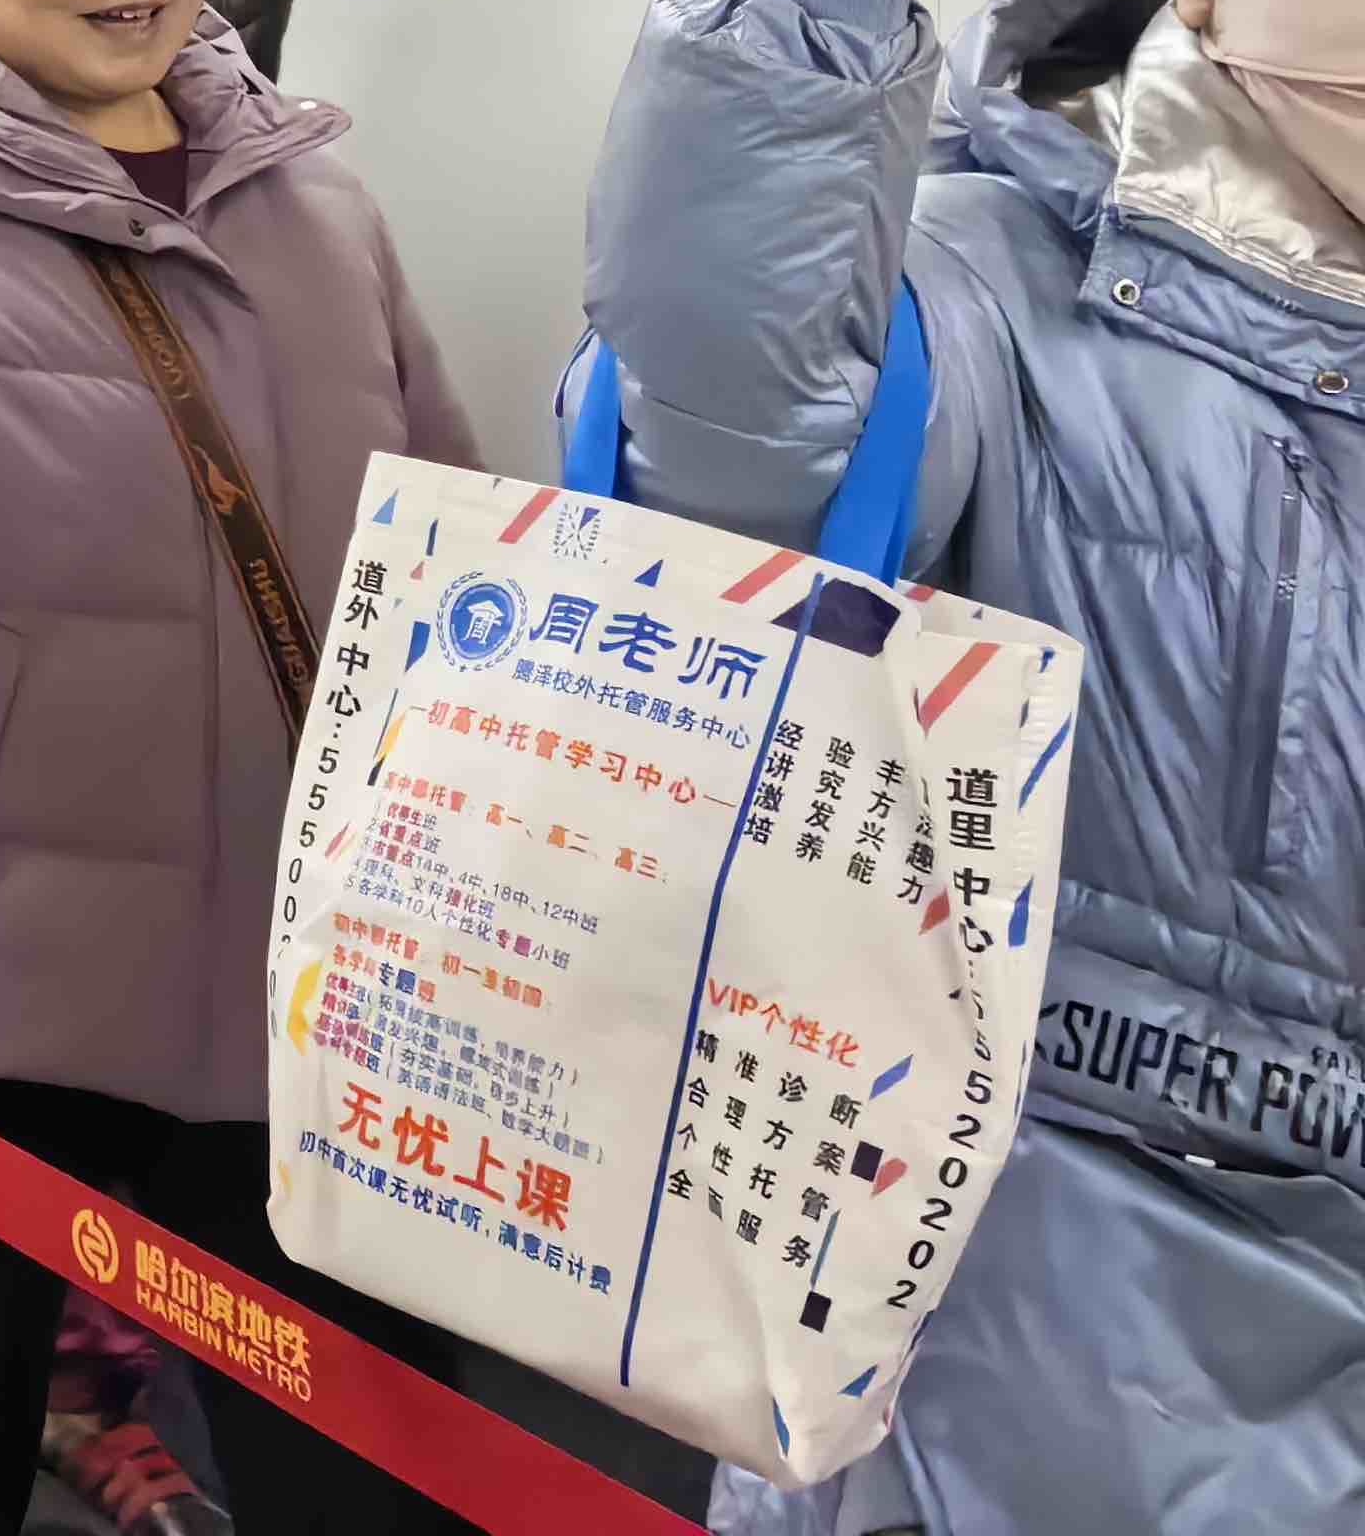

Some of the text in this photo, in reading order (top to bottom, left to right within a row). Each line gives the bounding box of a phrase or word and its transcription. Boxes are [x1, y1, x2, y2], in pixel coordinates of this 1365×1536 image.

[531, 592, 768, 701] 周老师
[773, 719, 931, 807] 经验丰
[743, 813, 926, 906] 培养能力
[753, 781, 935, 875] 激发兴趣
[708, 977, 859, 1069] VIP个性化
[1053, 1000, 1239, 1122] SUPER
[687, 1076, 846, 1176] 合理方案
[696, 1029, 862, 1130] 精准诊断
[338, 1081, 573, 1232] 无忧上课
[677, 1122, 830, 1222] 个性托管
[135, 1239, 312, 1376] 哈尔滨地铁
[136, 1286, 313, 1402] HARBIN METRO
